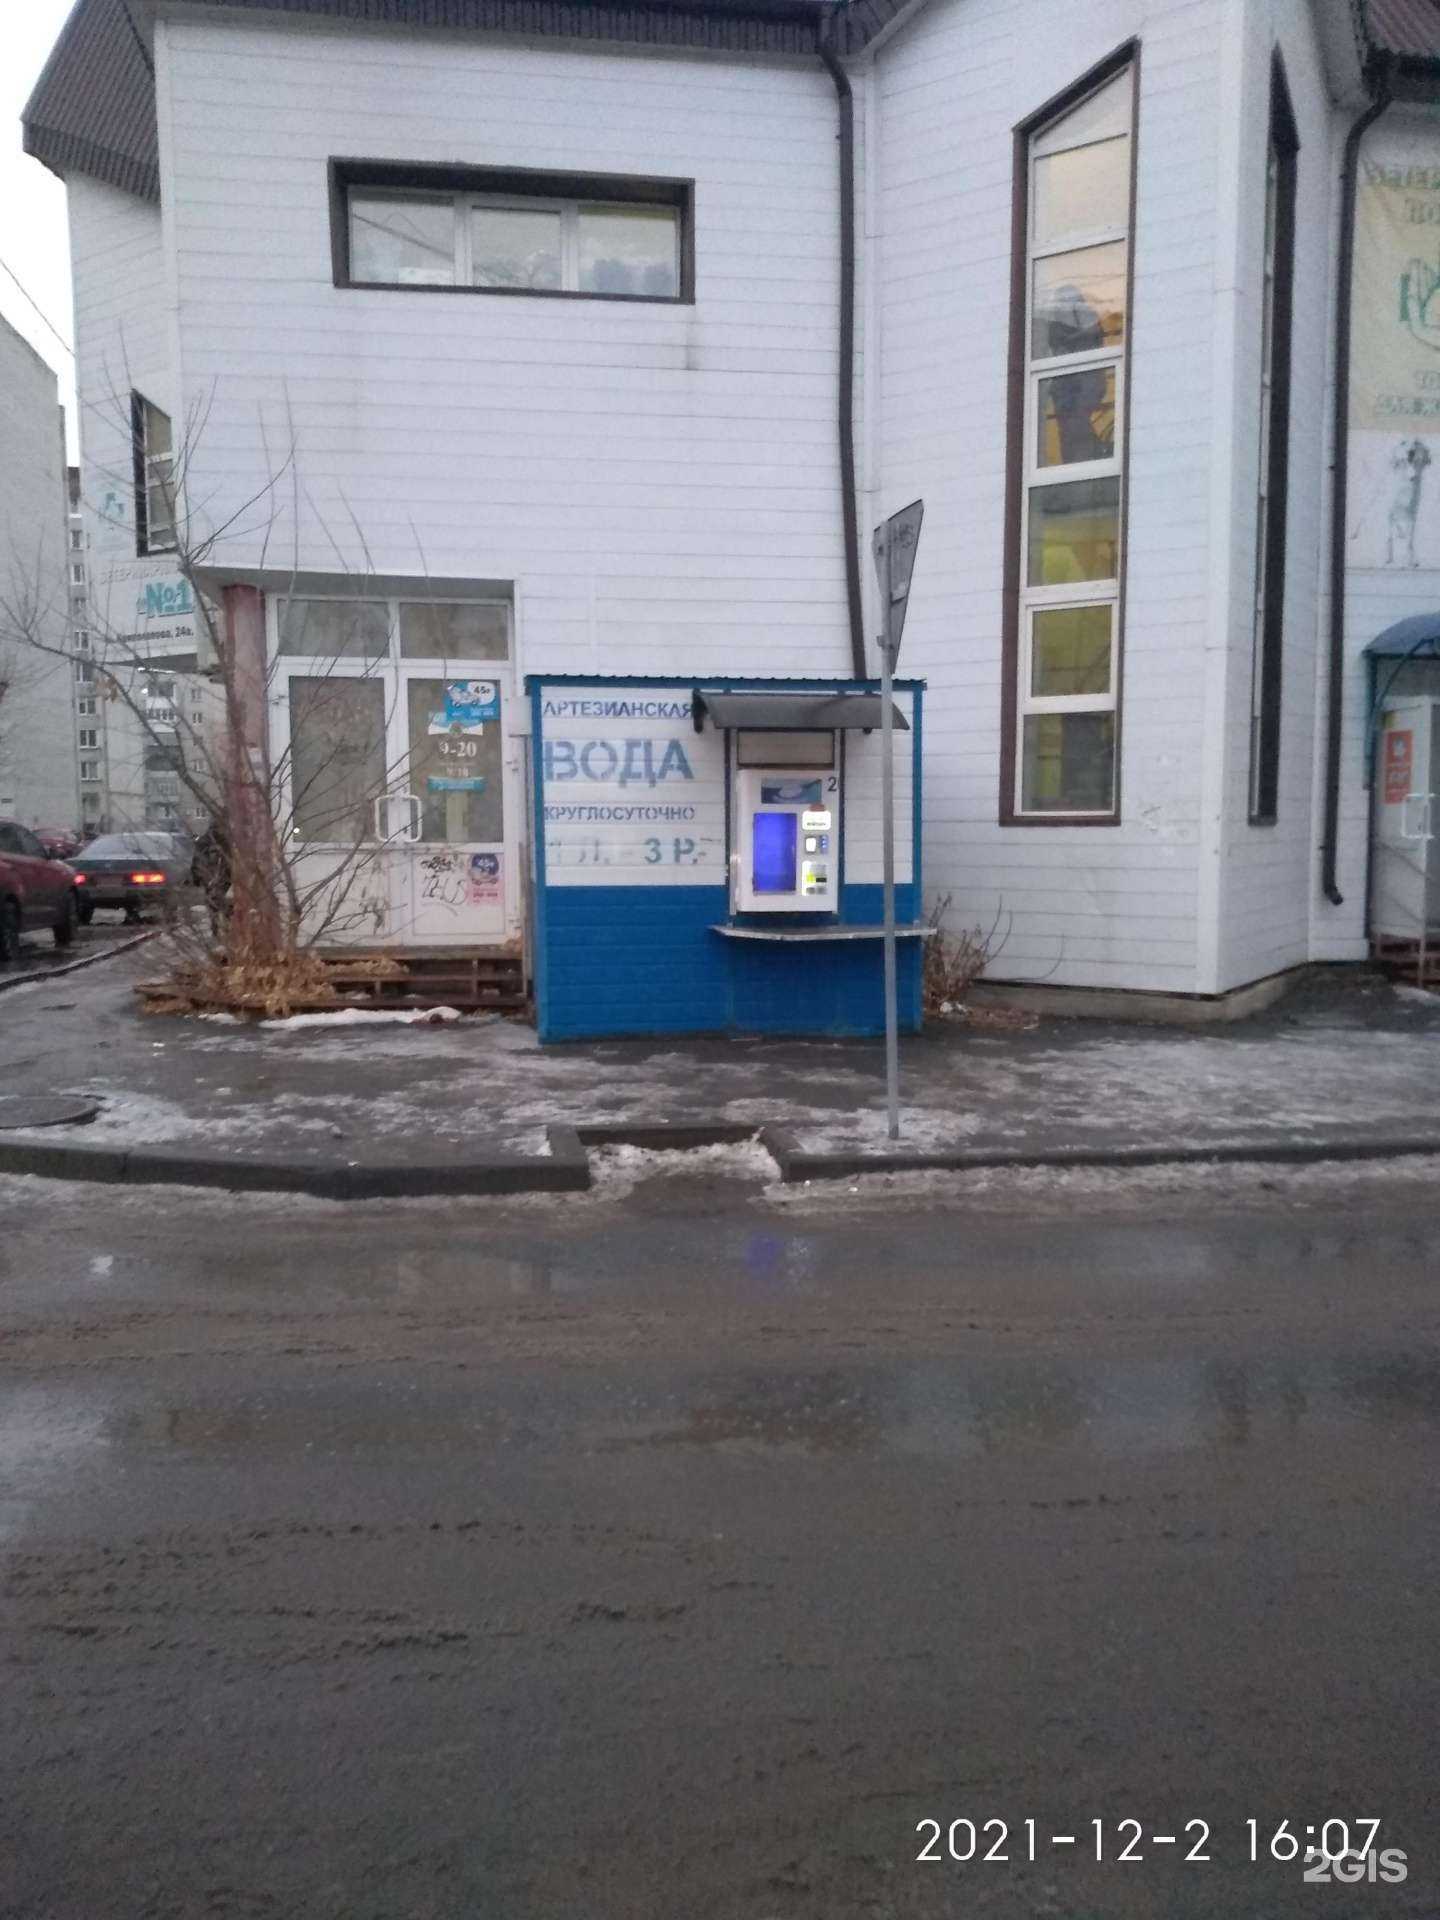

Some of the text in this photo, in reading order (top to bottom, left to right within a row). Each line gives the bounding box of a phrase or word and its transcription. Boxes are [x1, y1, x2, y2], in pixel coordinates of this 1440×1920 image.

[543, 700, 693, 718] АРТЕЗИАНСКАЯ
[544, 738, 694, 788] ВОДА
[827, 776, 838, 792] 2
[544, 805, 695, 820] КРУГЛОСУТОЧНО
[644, 837, 662, 864] 3
